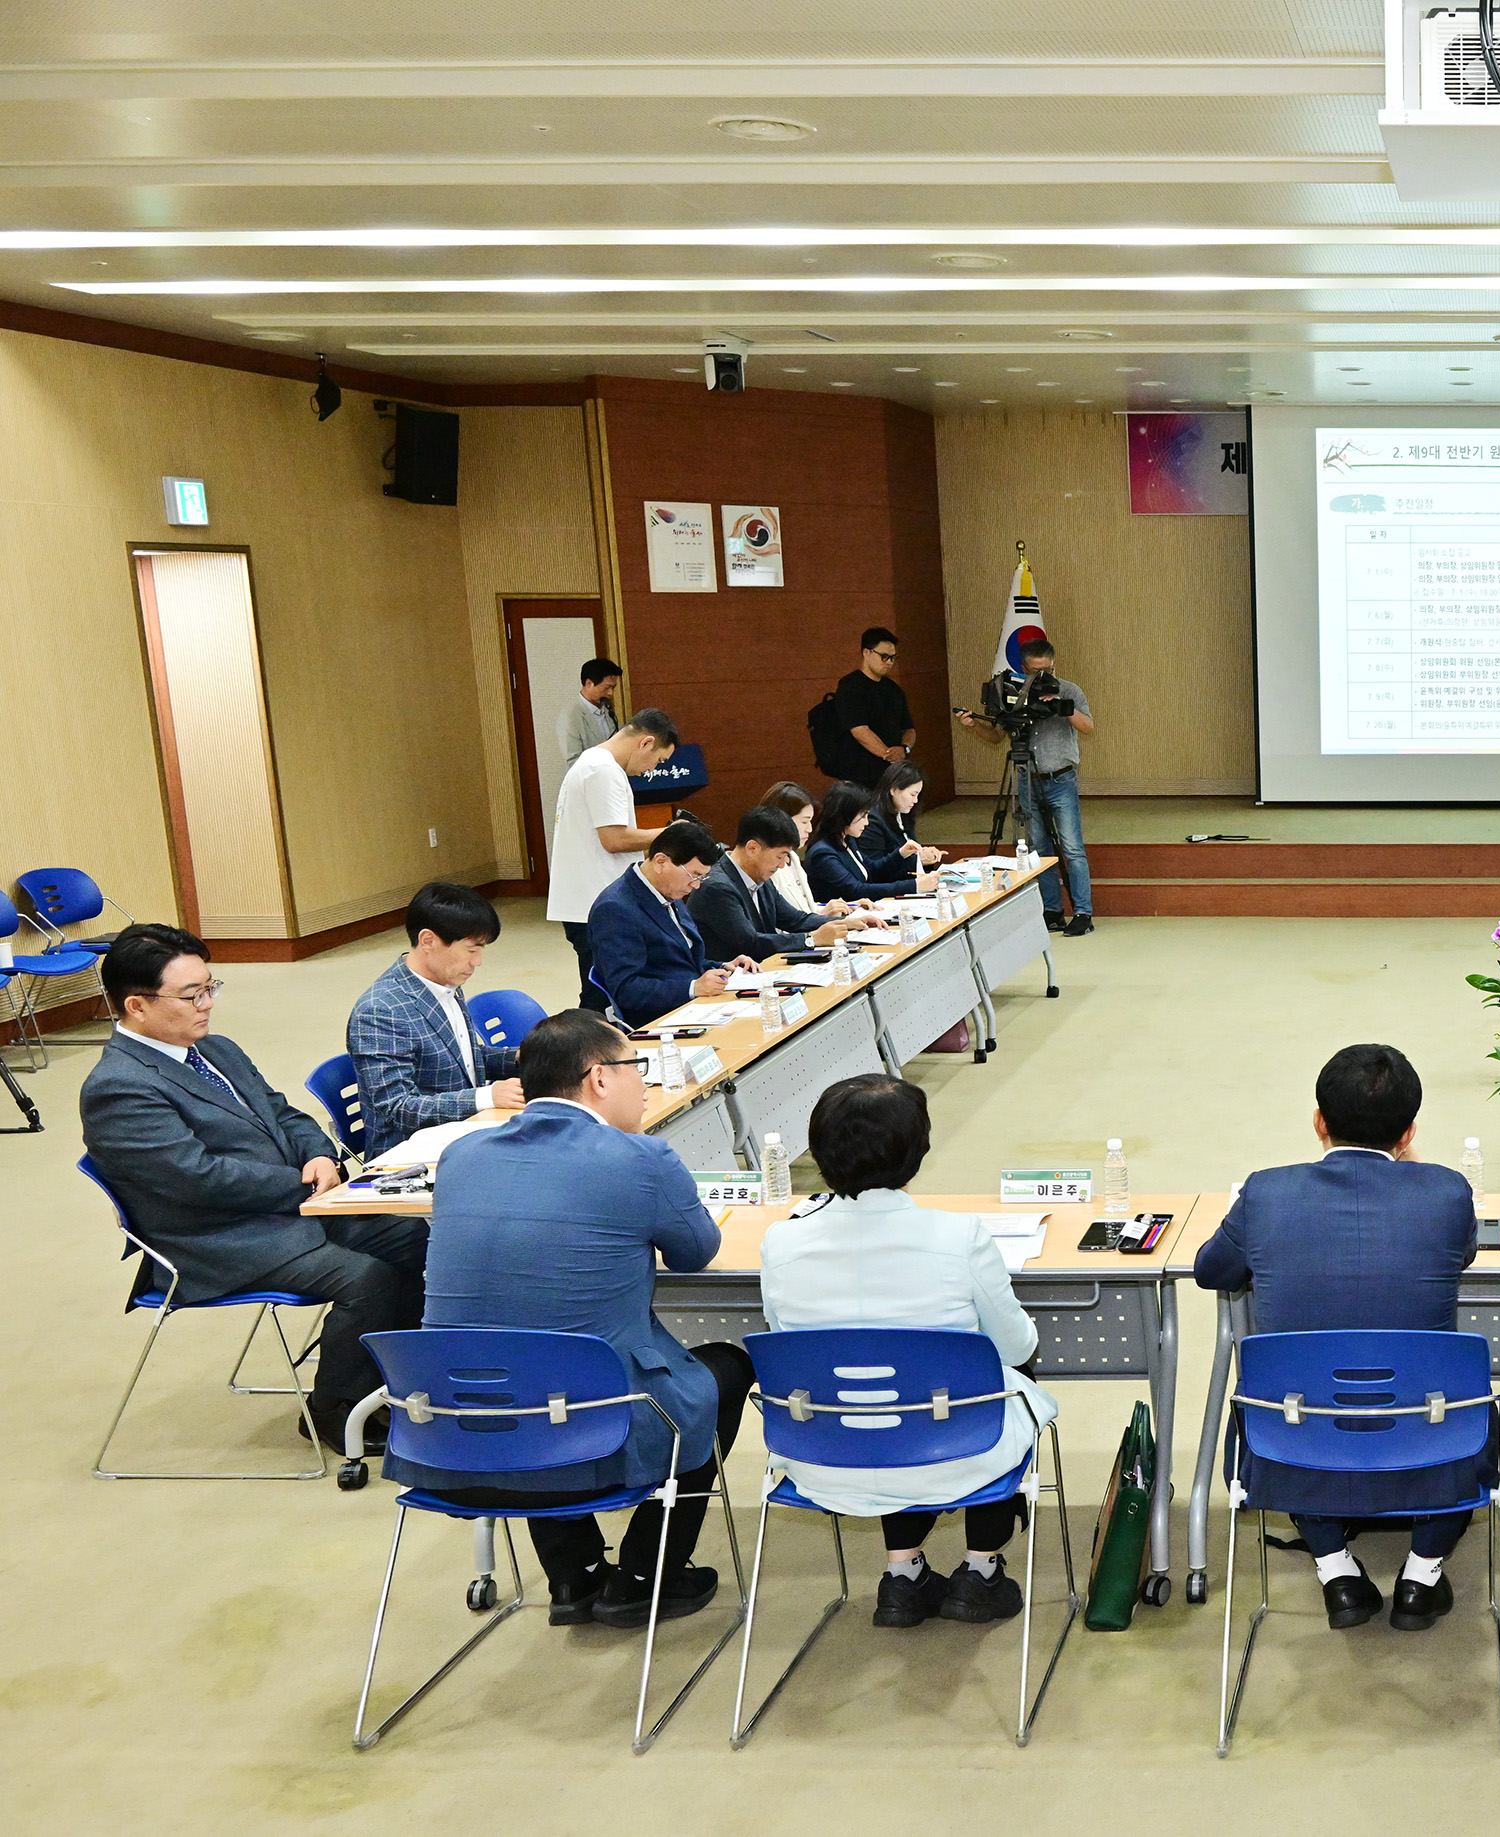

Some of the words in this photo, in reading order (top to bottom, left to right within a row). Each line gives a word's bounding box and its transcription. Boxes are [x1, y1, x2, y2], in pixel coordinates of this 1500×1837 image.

[1392, 445, 1404, 460] 2.
[1408, 445, 1441, 460] 제9대
[1446, 445, 1484, 460] 전반기
[1220, 442, 1247, 474] 제
[1395, 498, 1433, 509] 추진일정
[1418, 562, 1434, 570] 의장,
[1436, 562, 1458, 570] 부의장,
[1460, 562, 1495, 570] 상임위원장
[1418, 575, 1434, 584] 의장,
[1437, 575, 1458, 584] 부의장,
[1461, 575, 1495, 584] 상임위원장
[1419, 605, 1436, 614] 의장,
[1439, 605, 1462, 614] 부의장,
[1420, 658, 1456, 666] 상임위원회
[1459, 658, 1473, 666] 위원
[1420, 671, 1456, 679] 상임위원회
[1459, 671, 1489, 679] 부위원장
[1469, 687, 1483, 696] 구성
[1420, 700, 1444, 708] 위원장,
[1447, 700, 1475, 708] 부위원장
